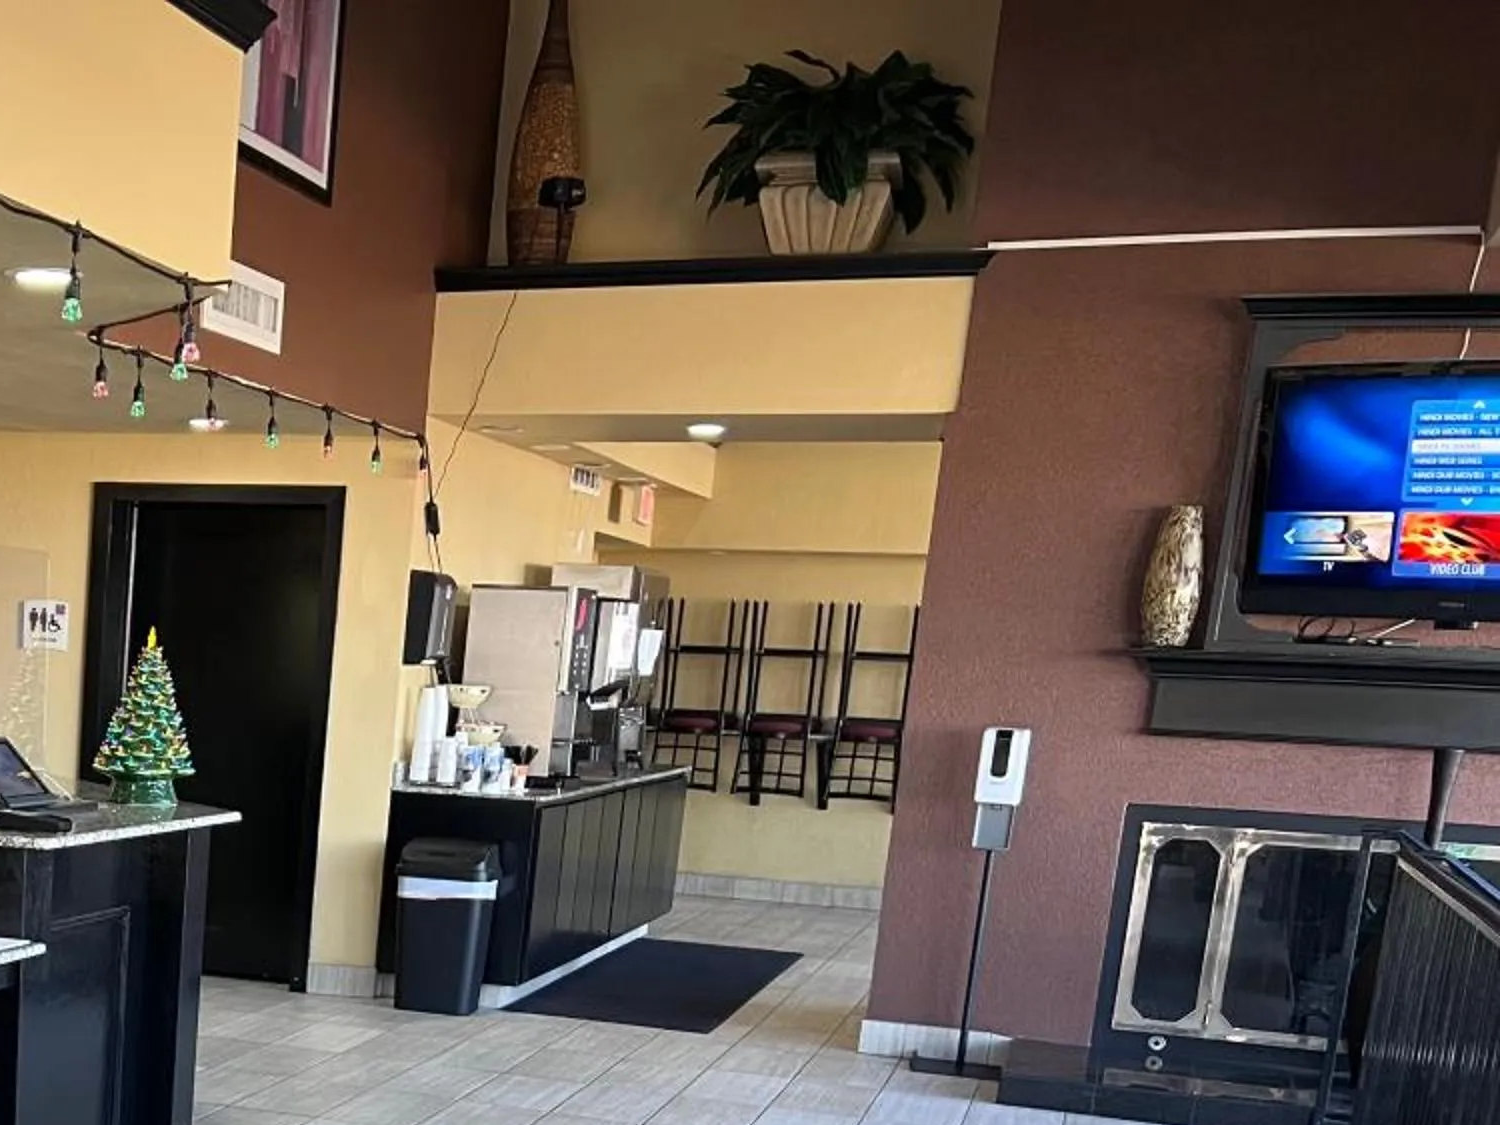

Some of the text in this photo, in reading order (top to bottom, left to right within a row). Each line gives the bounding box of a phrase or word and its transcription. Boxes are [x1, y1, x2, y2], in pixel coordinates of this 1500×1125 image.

[1323, 561, 1335, 571] TV
[1429, 562, 1485, 576] VIDEO CLUB
